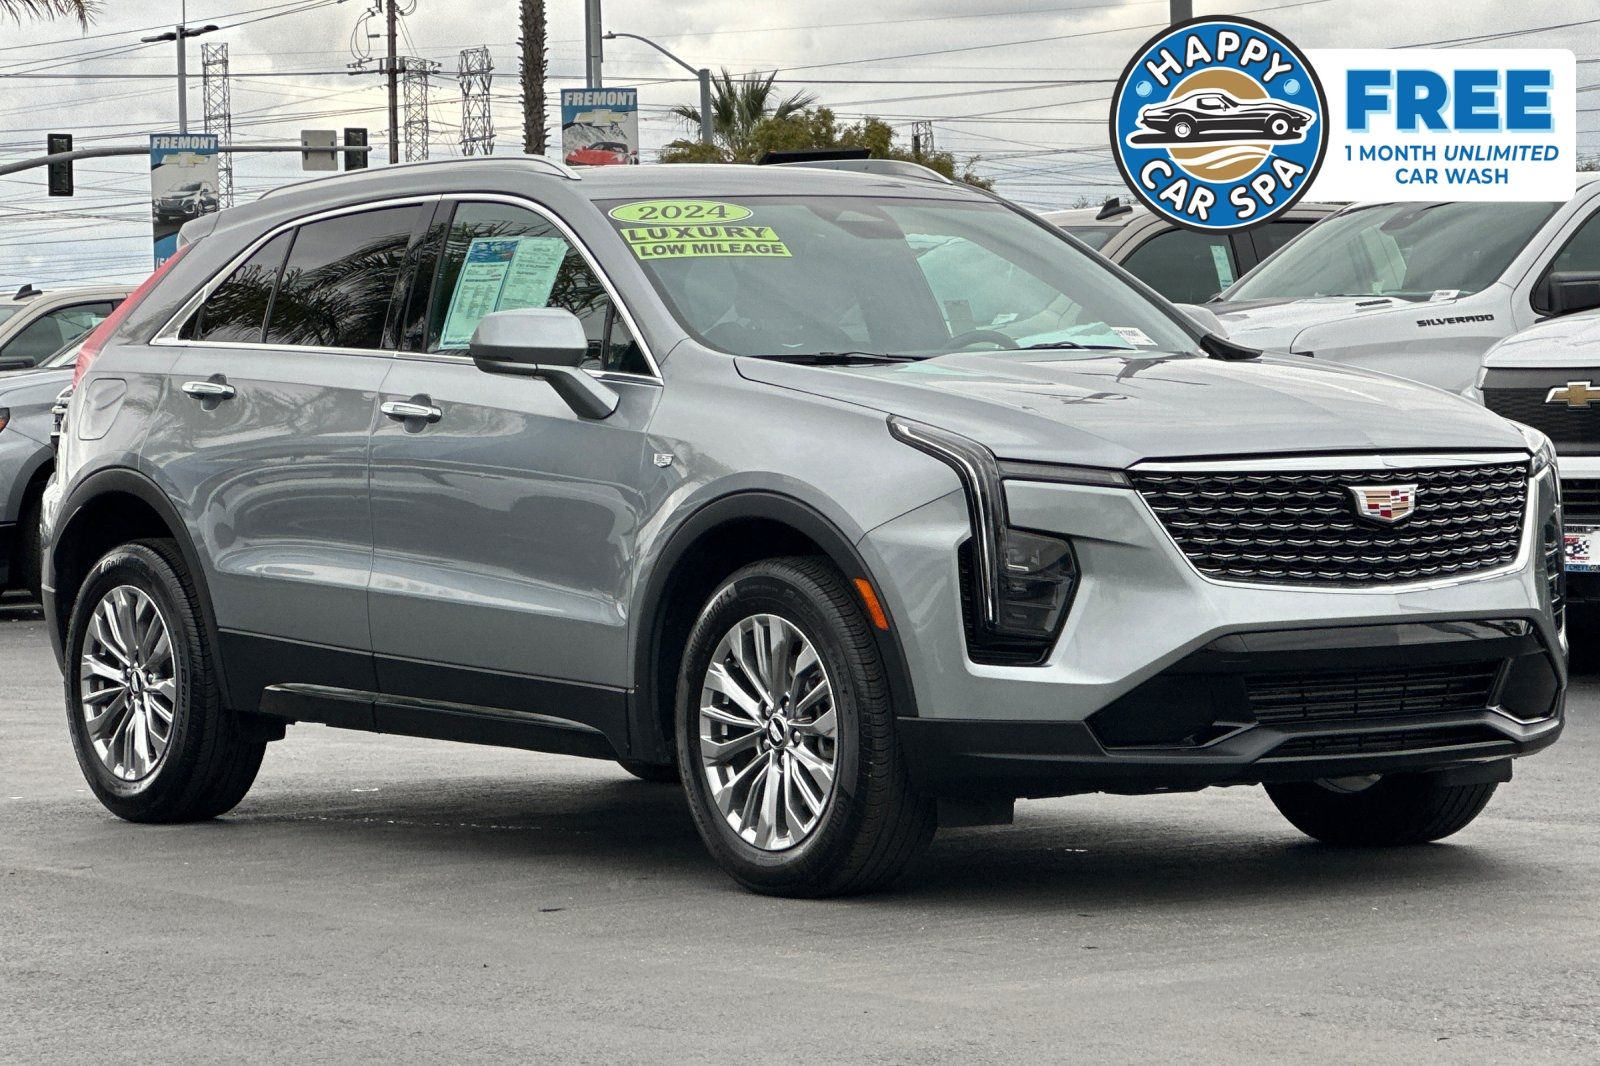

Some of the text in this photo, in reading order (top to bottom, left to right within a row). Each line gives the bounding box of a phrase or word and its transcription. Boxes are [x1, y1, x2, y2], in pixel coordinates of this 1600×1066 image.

[563, 91, 636, 106] FREMONT
[151, 136, 217, 149] FREMONT
[638, 204, 730, 220] 2024
[628, 226, 770, 242] LUXURY
[640, 243, 786, 257] LOW MILEAGE
[1416, 314, 1495, 327] SILVERADO
